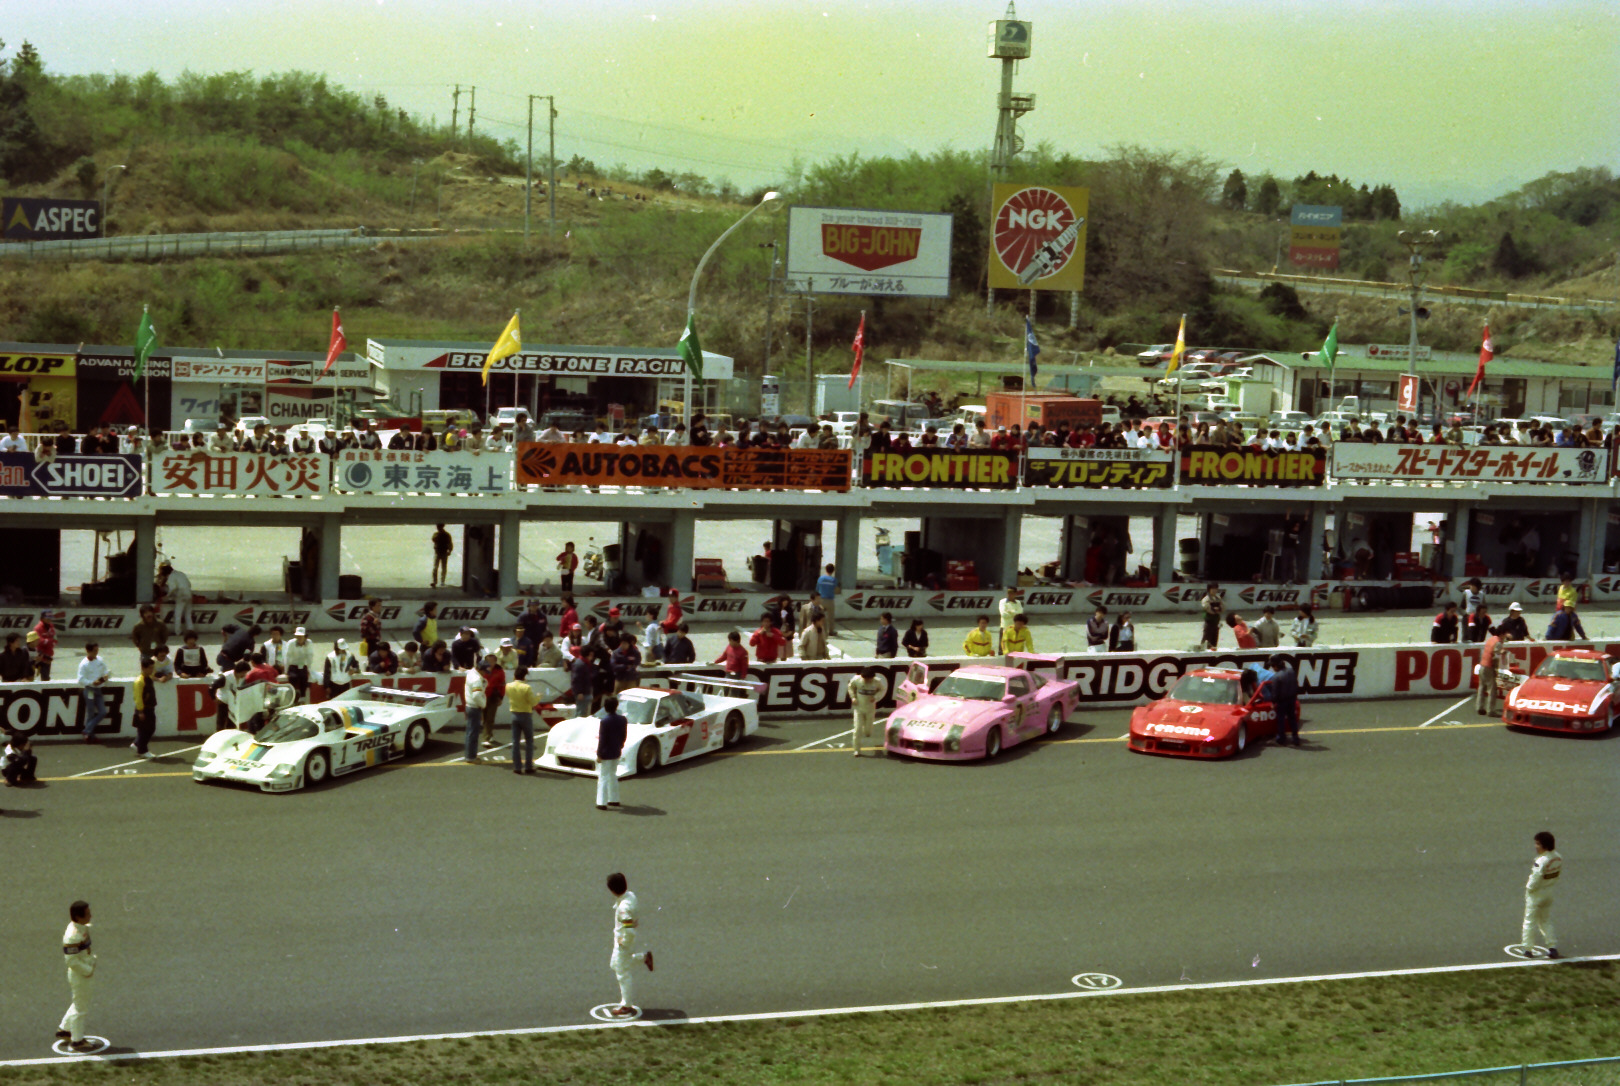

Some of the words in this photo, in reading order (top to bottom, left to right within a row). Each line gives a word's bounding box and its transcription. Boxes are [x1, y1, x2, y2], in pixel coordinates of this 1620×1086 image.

[34, 207, 97, 233] ASPEC
[1009, 208, 1065, 231] NGK
[825, 226, 917, 257] BIG-JOHN
[79, 358, 121, 367] ADVAN
[616, 358, 686, 374] RACIN
[268, 367, 311, 377] CHAMPION
[340, 369, 368, 378] SERVICE
[560, 451, 721, 479] AUTOBACS
[870, 452, 1010, 483] FRONTIER
[1188, 451, 1316, 480] FRONTIER
[1392, 448, 1559, 478] スピードスターホイール
[47, 463, 124, 487] SHOEI
[162, 453, 321, 492] 安田火災
[382, 463, 504, 491] 東京海上
[1049, 462, 1167, 484] フロンティア
[865, 596, 914, 609] ENKEI
[946, 596, 995, 609] ENKEI
[1026, 592, 1073, 605] ENKEI
[1103, 593, 1150, 606] ENKEI
[1255, 589, 1301, 602] ENKEI
[438, 607, 491, 620] ENKEI
[697, 599, 747, 612] ENKEI
[69, 615, 125, 629] ENKEI
[256, 611, 311, 625] ENKEI
[1515, 699, 1589, 714] クロスロード
[702, 721, 709, 740] 9
[1145, 722, 1211, 737] renoma
[352, 730, 402, 753] TRUST
[339, 742, 347, 765] 1
